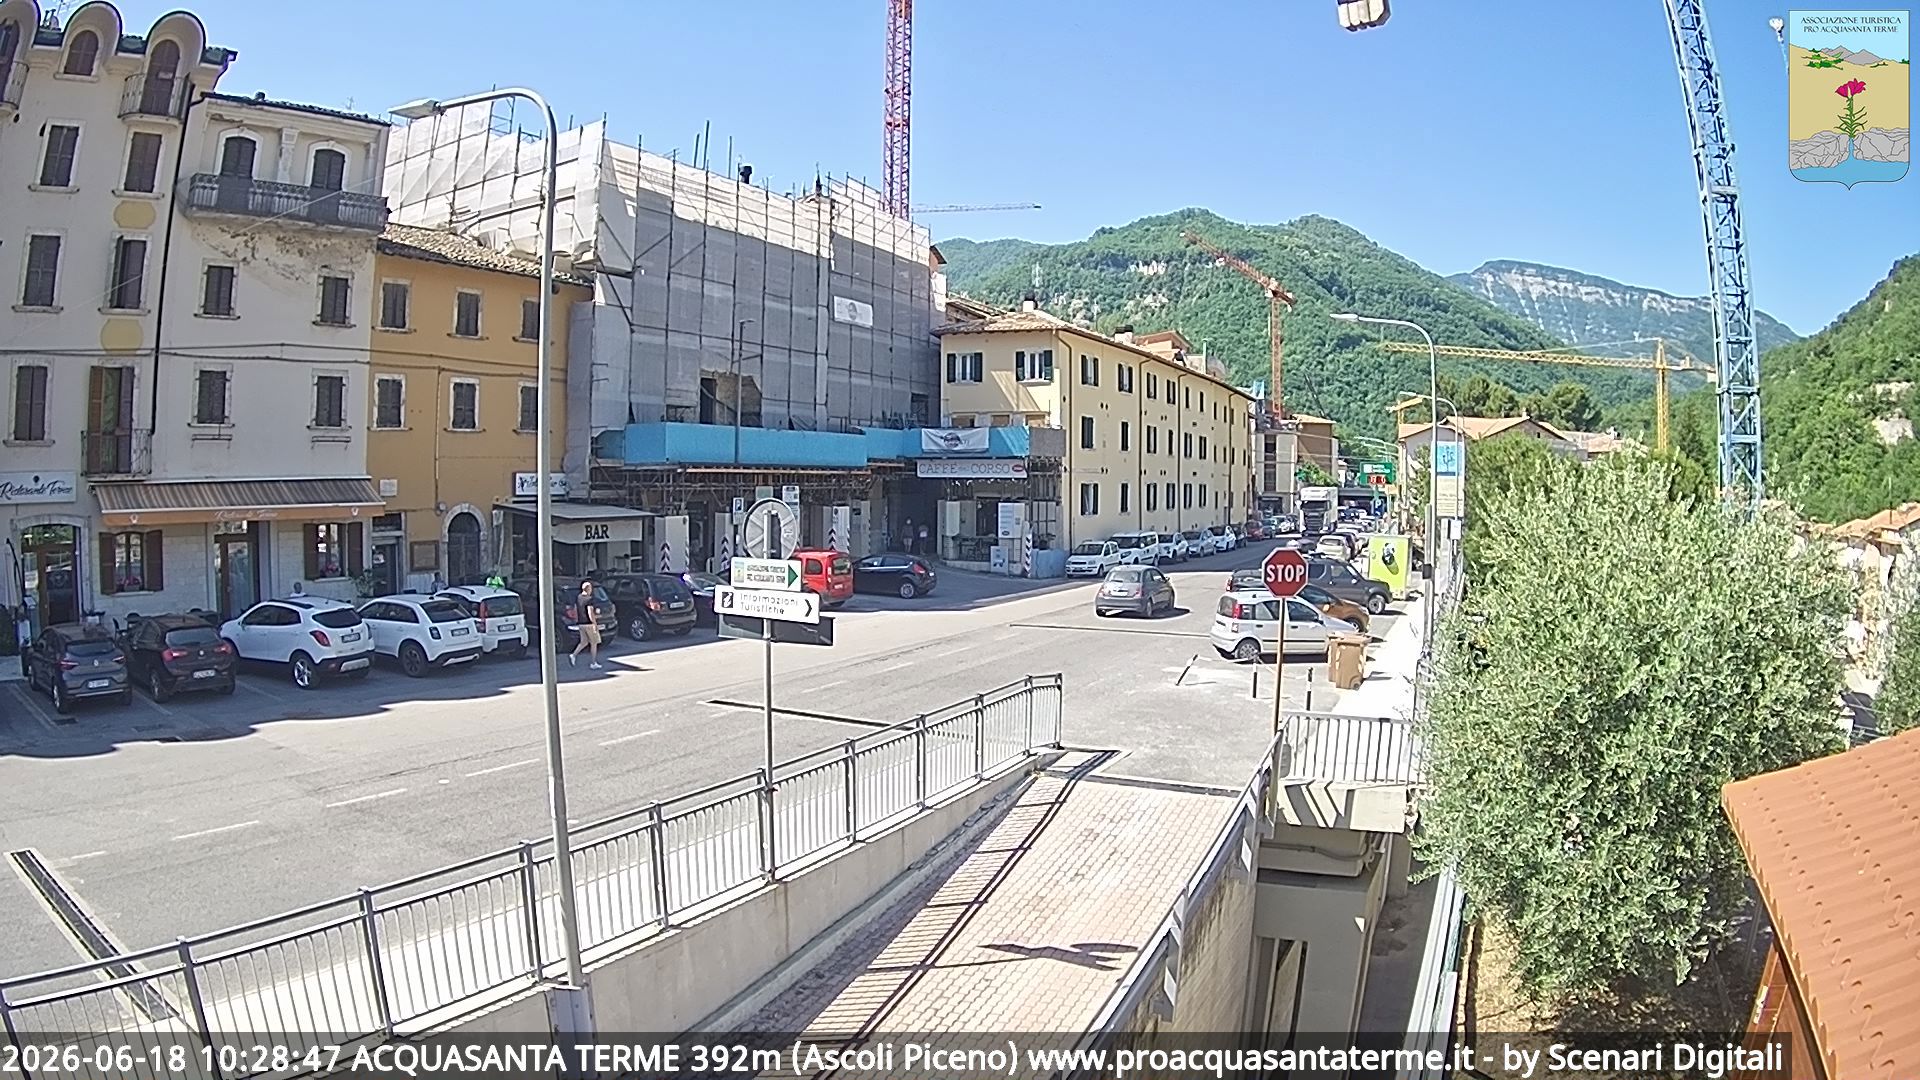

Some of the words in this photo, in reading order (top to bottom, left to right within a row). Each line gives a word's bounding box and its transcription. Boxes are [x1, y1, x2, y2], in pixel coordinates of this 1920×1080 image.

[970, 463, 1010, 474] CORSO
[585, 524, 610, 540] BAR
[1266, 564, 1305, 583] STOP
[740, 593, 799, 607] Informazioni
